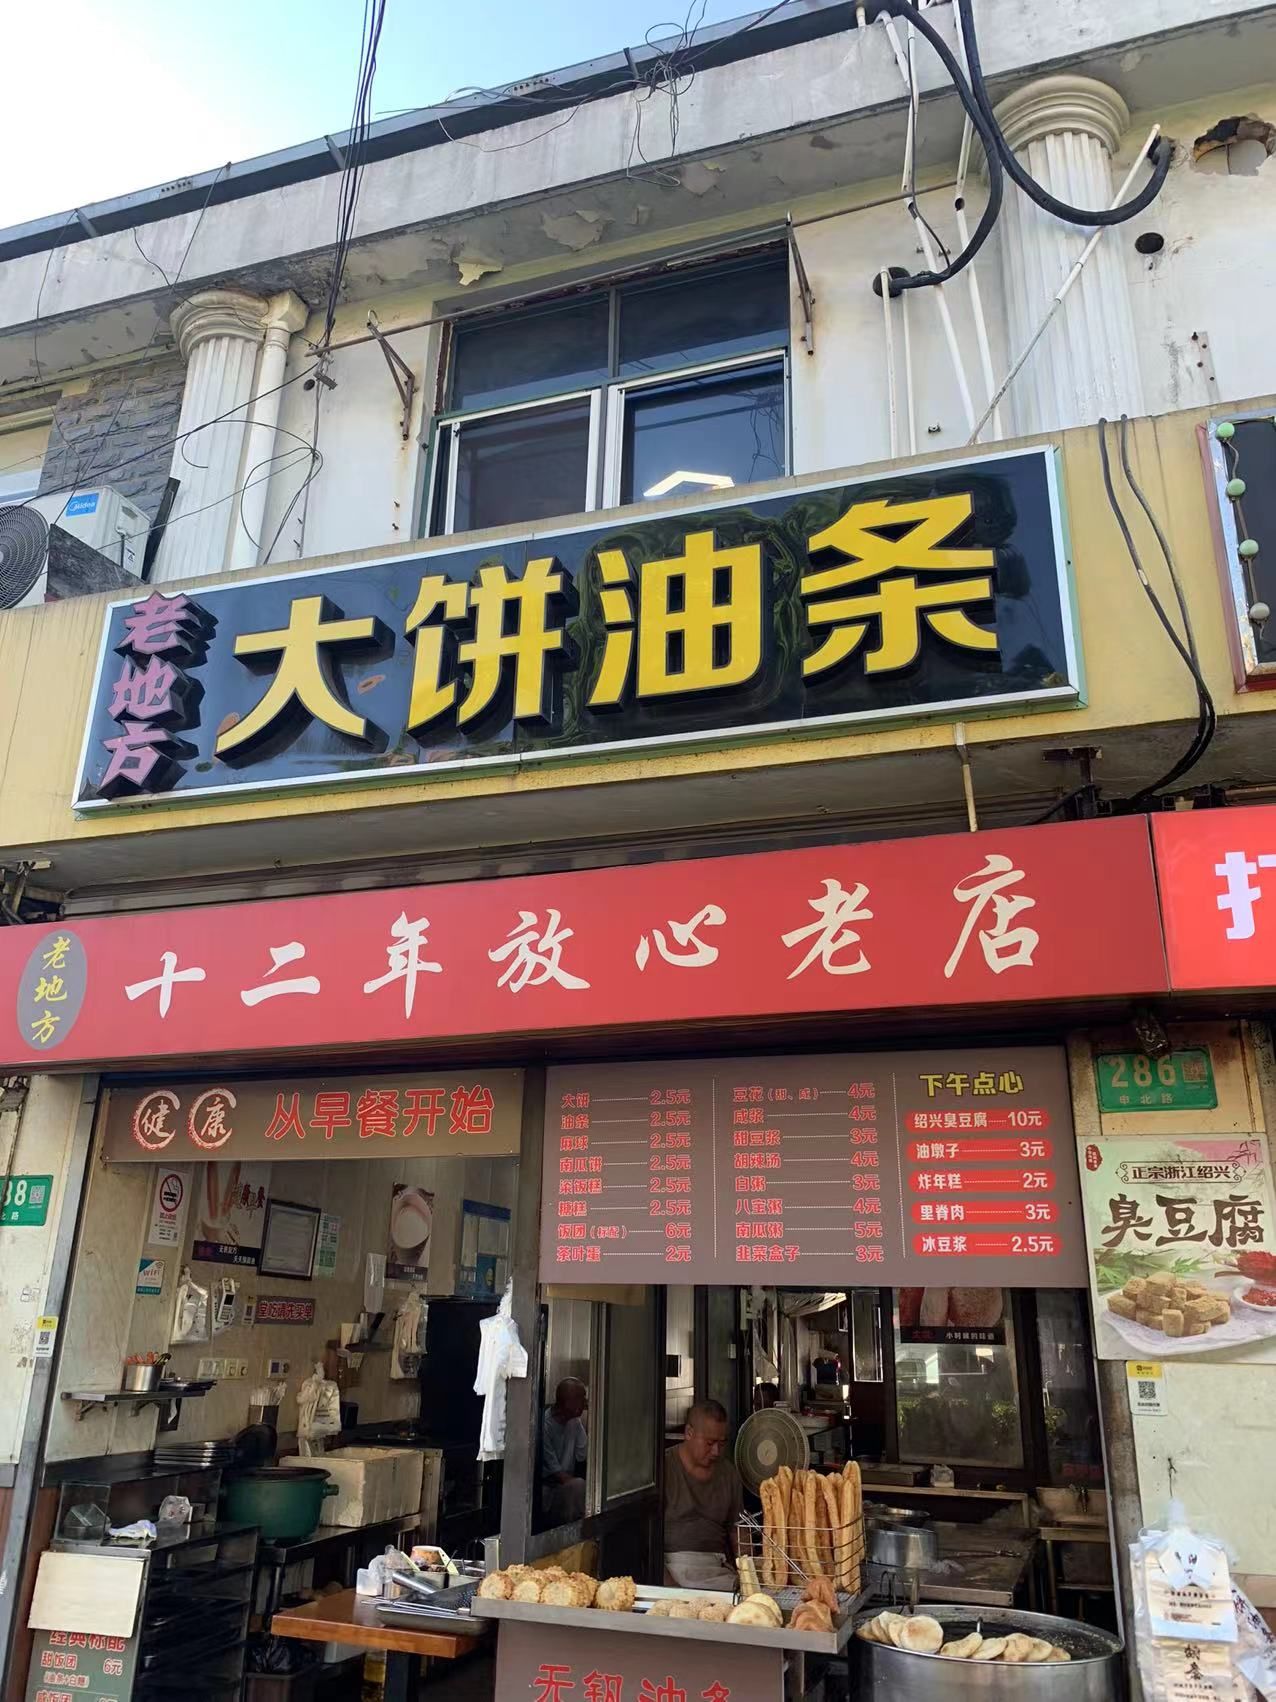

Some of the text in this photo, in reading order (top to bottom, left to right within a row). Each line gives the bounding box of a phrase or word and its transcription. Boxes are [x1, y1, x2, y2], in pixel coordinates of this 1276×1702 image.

[215, 491, 999, 755] 大饼油条
[101, 590, 195, 788] 老地方
[125, 854, 1039, 1019] 十二年放心老店
[31, 935, 72, 1044] 老地方
[1108, 1055, 1177, 1087] 286
[848, 1083, 876, 1099] 4元
[920, 1071, 1024, 1097] 下午点心
[561, 1089, 691, 1108] 大饼 2.5元
[265, 1085, 494, 1140] 从早餐开始
[560, 1111, 691, 1129] 油条 2.5元
[733, 1105, 876, 1124] 咸浆 4元
[914, 1110, 1042, 1129] 绍兴臭豆腐 10元
[560, 1131, 691, 1151] 麻球 2.5元
[733, 1129, 877, 1146] 甜豆浆 3元
[916, 1141, 1045, 1158] 油墩子 3元
[560, 1155, 691, 1173] 南瓜饼 2.5元
[734, 1151, 879, 1169] 胡辣汤 4元
[917, 1172, 1048, 1190] 炸年糕 2元
[1132, 1165, 1231, 1179] 正宗浙江绍兴
[650, 1177, 691, 1193] 2.5元
[735, 1175, 880, 1192] 白粥 3元
[650, 1200, 691, 1216] 2.5元
[735, 1198, 881, 1215] 八宝粥 4元
[920, 1204, 1051, 1221] 里脊肉 3元
[1101, 1193, 1265, 1248] 臭豆腐
[665, 1222, 692, 1238] 6元
[735, 1222, 883, 1239] 南瓜粥 5元
[922, 1235, 1054, 1252] 冰豆浆 2.5元
[556, 1245, 692, 1263] 茶叶蛋 2元
[735, 1245, 884, 1262] 韭菜盒子 3元
[49, 1631, 125, 1652] 经典标配
[41, 1651, 123, 1675] 甜饭团 6元
